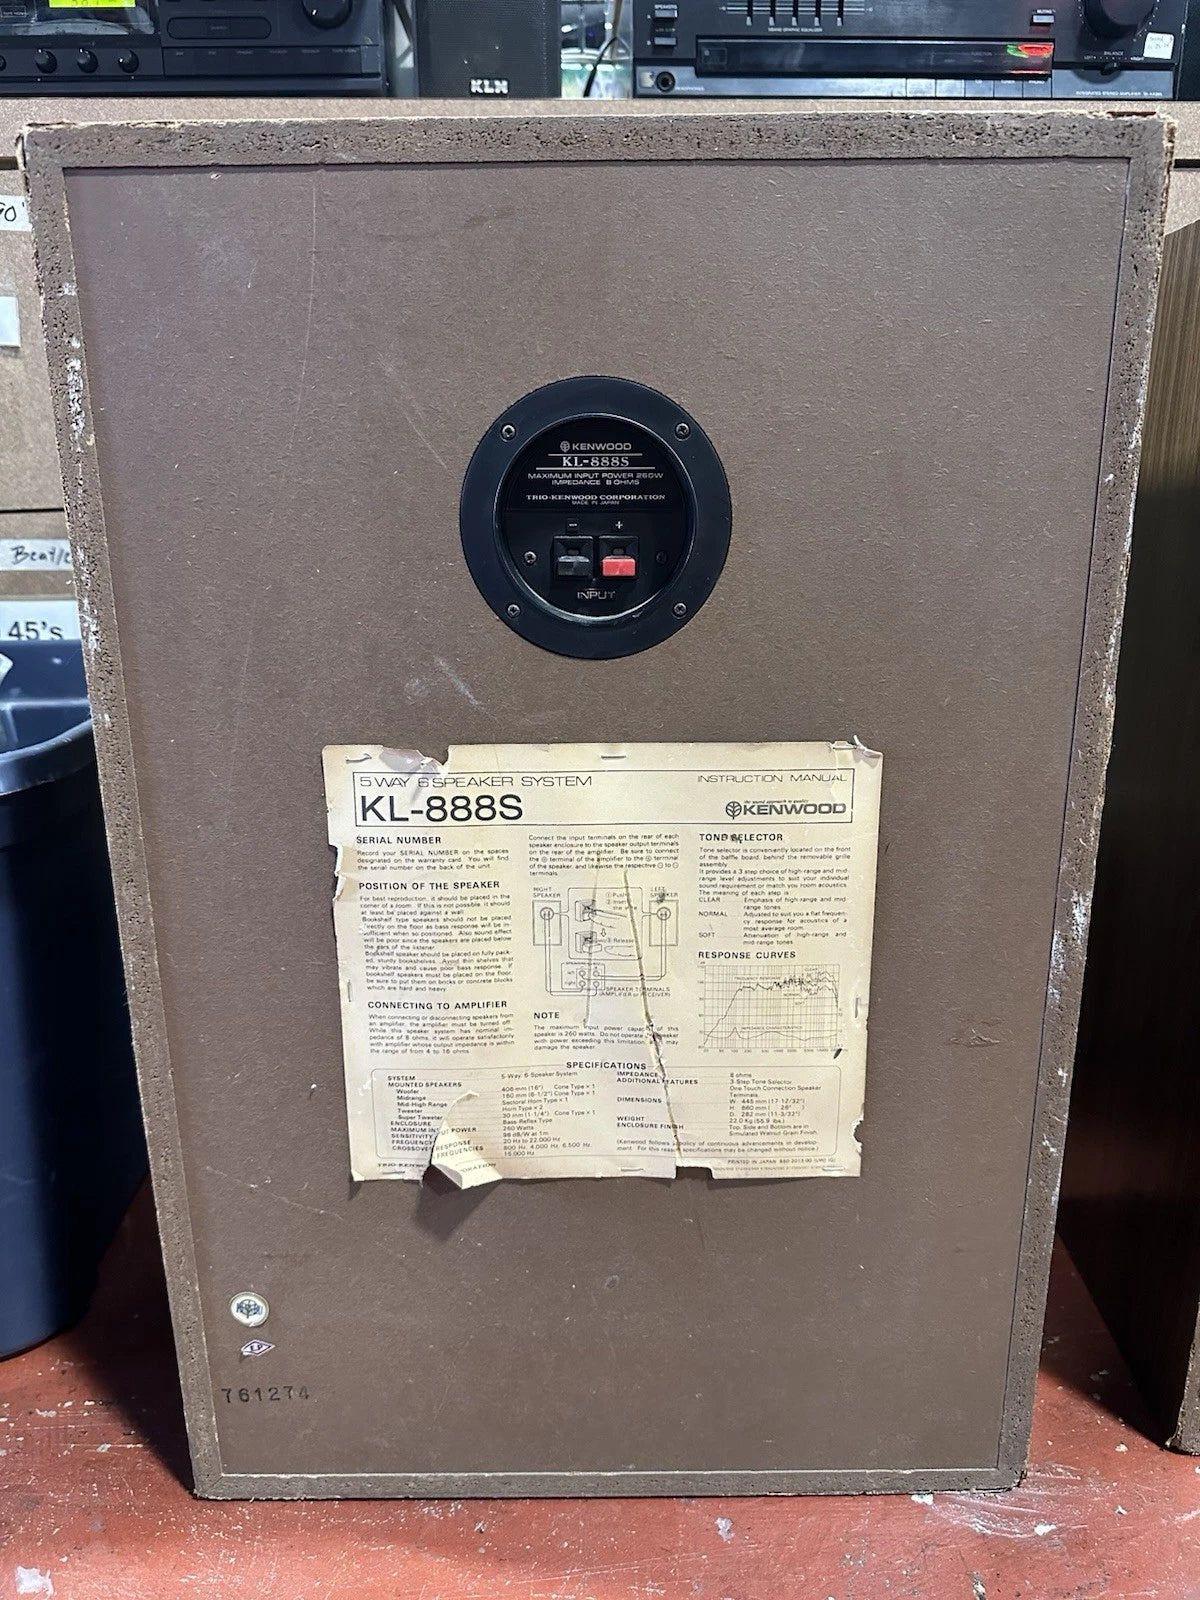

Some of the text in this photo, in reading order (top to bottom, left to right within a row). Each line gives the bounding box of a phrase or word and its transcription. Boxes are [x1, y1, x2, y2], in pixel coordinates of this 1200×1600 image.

[573, 443, 631, 451] KENWOOD
[562, 457, 629, 467] KL-888S
[577, 591, 616, 599] INPUT
[8, 621, 64, 640] 45's
[360, 775, 592, 788] 5 WAY 6 SPEAKER SYSTEM
[698, 774, 847, 783] INSTRUCTION MANUAL
[361, 794, 523, 822] KL-888S
[743, 803, 846, 815] KENWOOD
[356, 836, 441, 844] SERIAL NUMBER
[700, 833, 728, 841] TONE
[358, 882, 407, 890] POSITION
[430, 882, 448, 890] THE
[698, 951, 796, 959] RESPONSE CURVES
[367, 1001, 433, 1009] CONNECTING
[455, 1001, 507, 1009] AMPLIFIER
[566, 1061, 647, 1069] SPECIFICATIONS
[518, 1104, 532, 1112] Type
[436, 1140, 471, 1151] RESPONSE
[437, 1146, 484, 1159] FREQUENCIES
[221, 1385, 310, 1403] 761274
